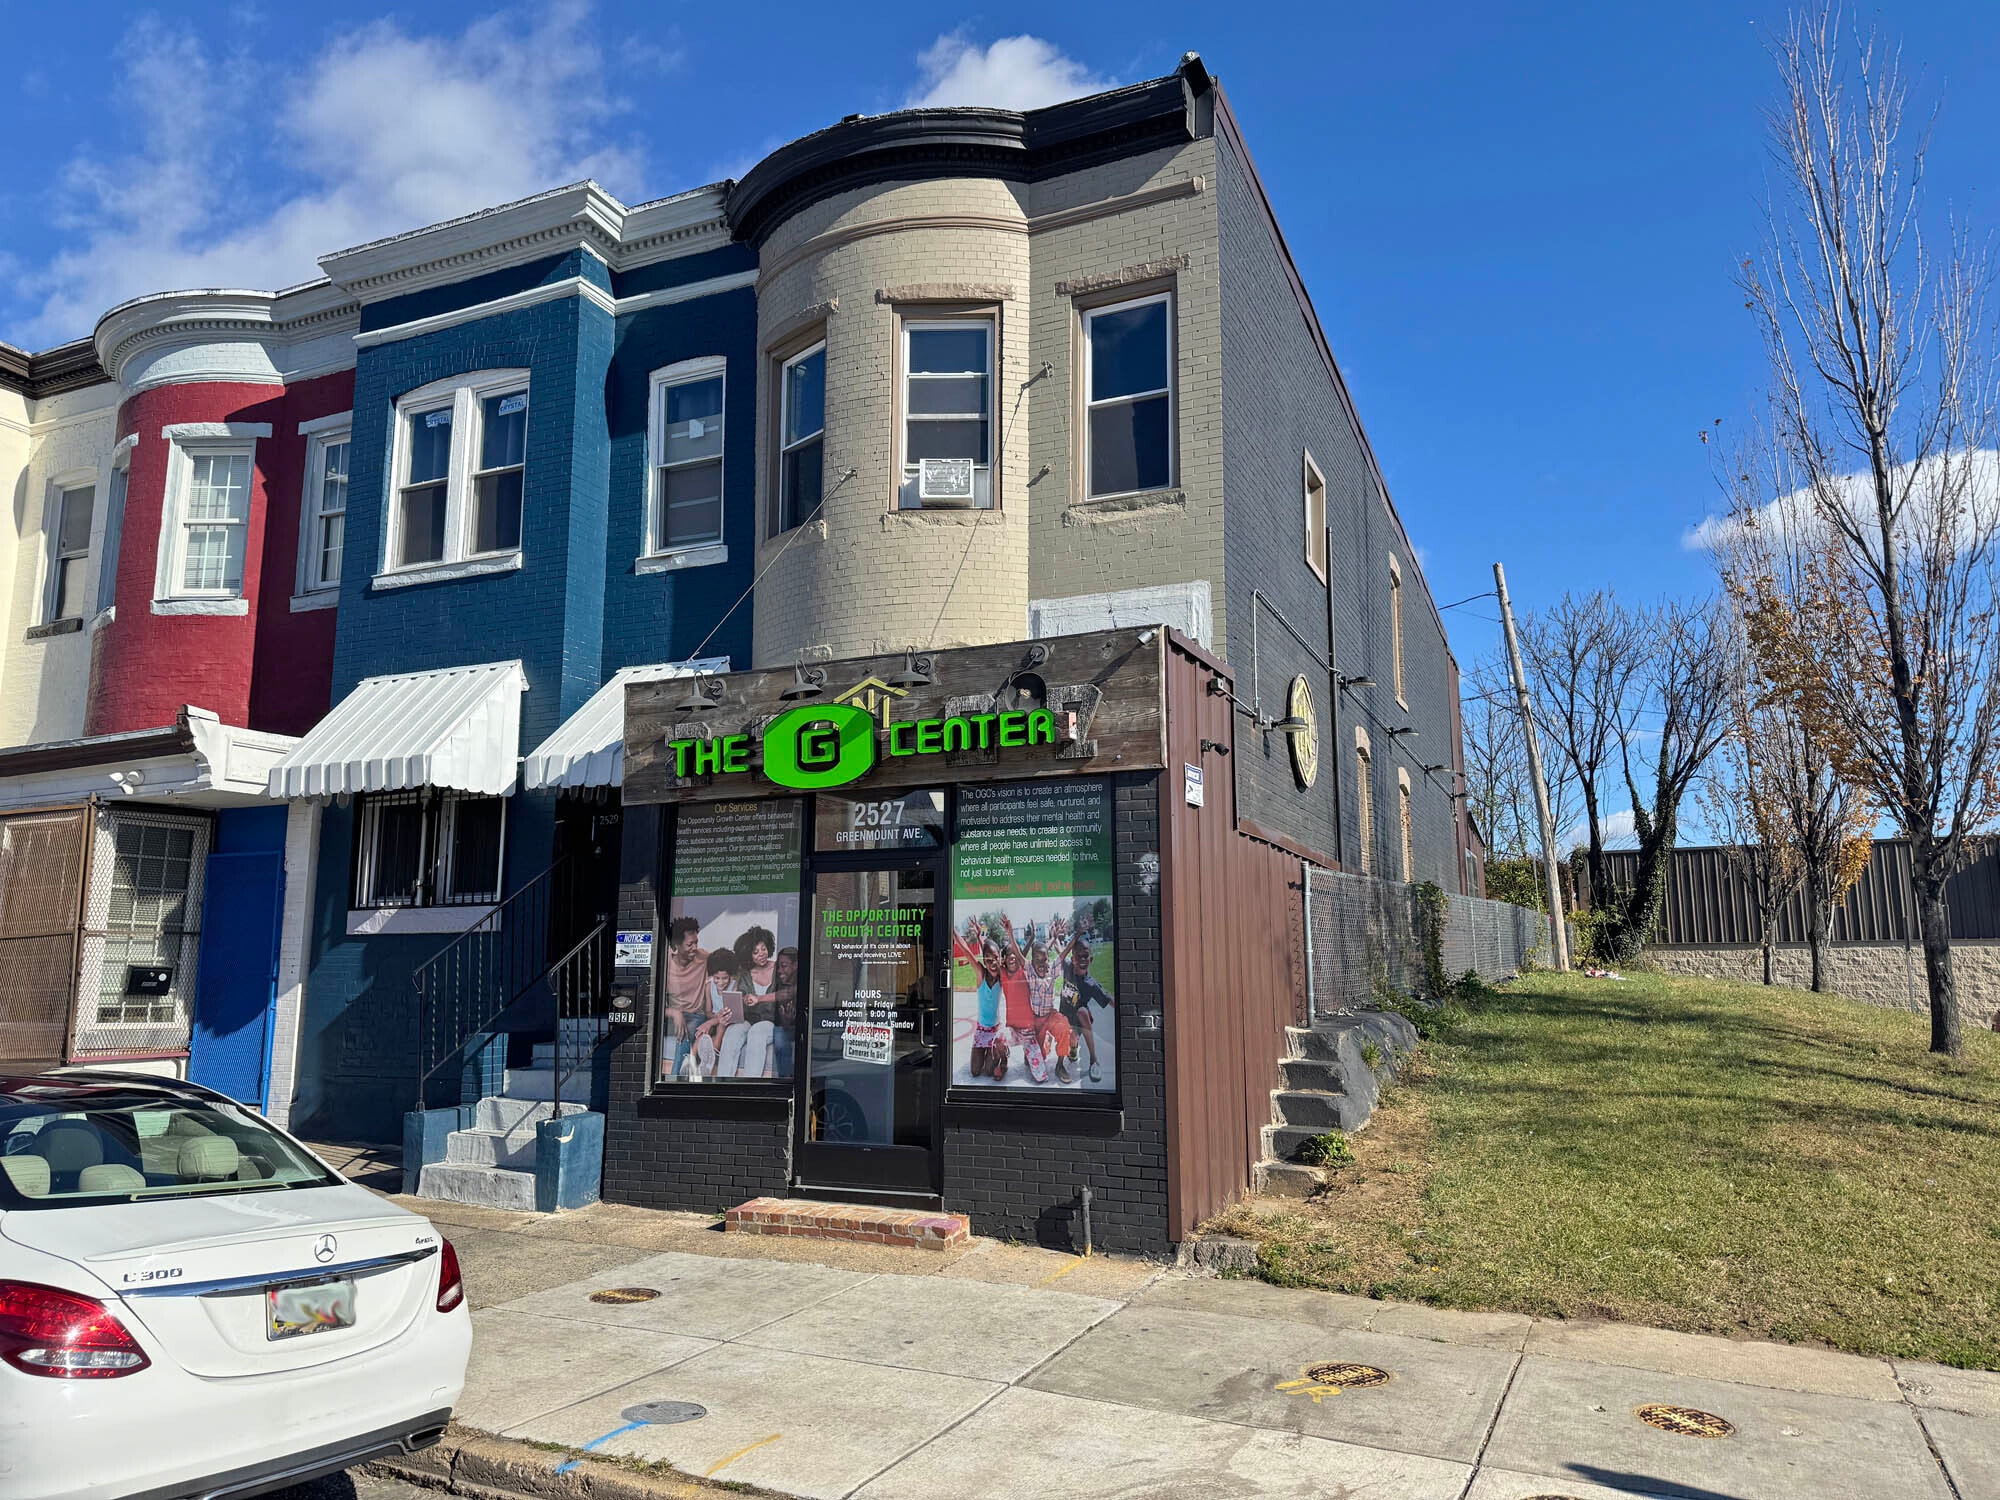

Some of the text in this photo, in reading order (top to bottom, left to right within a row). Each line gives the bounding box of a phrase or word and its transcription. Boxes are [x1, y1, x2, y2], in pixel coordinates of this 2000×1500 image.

[500, 401, 525, 412] CRYSTAL
[668, 734, 749, 777] THE
[890, 708, 1055, 756] CENTER
[962, 790, 973, 799] The
[976, 789, 995, 798] OGC's
[998, 788, 1015, 796] vision
[1017, 788, 1022, 796] is
[1024, 787, 1031, 795] to
[1032, 786, 1052, 795] create
[1064, 783, 1102, 793] atmosphere
[715, 802, 757, 813] Our Services
[961, 803, 979, 812] where
[990, 800, 1025, 812] participants
[1027, 800, 1038, 808] feel
[1040, 799, 1055, 807] safe,
[1058, 797, 1085, 806] nurtured,
[1088, 796, 1100, 805] and
[854, 801, 905, 827] 2527
[961, 810, 1099, 825] motivated to address their mental health and
[836, 827, 923, 842] GREENMOUNT AVE.
[961, 829, 992, 838] substance
[994, 828, 1005, 836] use
[1030, 826, 1036, 834] to
[1038, 826, 1058, 834] create
[1066, 824, 1101, 834] community
[961, 842, 979, 851] where
[990, 841, 1010, 852] people
[1012, 840, 1028, 848] have
[1030, 839, 1058, 848] unlimited
[1059, 839, 1083, 847] access
[1085, 838, 1091, 846] to
[961, 856, 991, 865] behavioral
[993, 855, 1011, 864] health
[1014, 854, 1044, 863] resources
[1046, 852, 1069, 862] needed
[961, 867, 1015, 879] not just to survive.
[822, 909, 926, 922] THE OPPORTUNITY
[826, 925, 921, 938] GROWTH CENTER
[855, 990, 881, 999] HOURS
[842, 1000, 866, 1009] Monday
[874, 1000, 894, 1009] Friday
[609, 1013, 635, 1023] 2527
[888, 1011, 897, 1019] pm
[891, 1020, 914, 1029] Sunday
[849, 1047, 869, 1057] Cameras
[141, 1267, 183, 1281] 300
